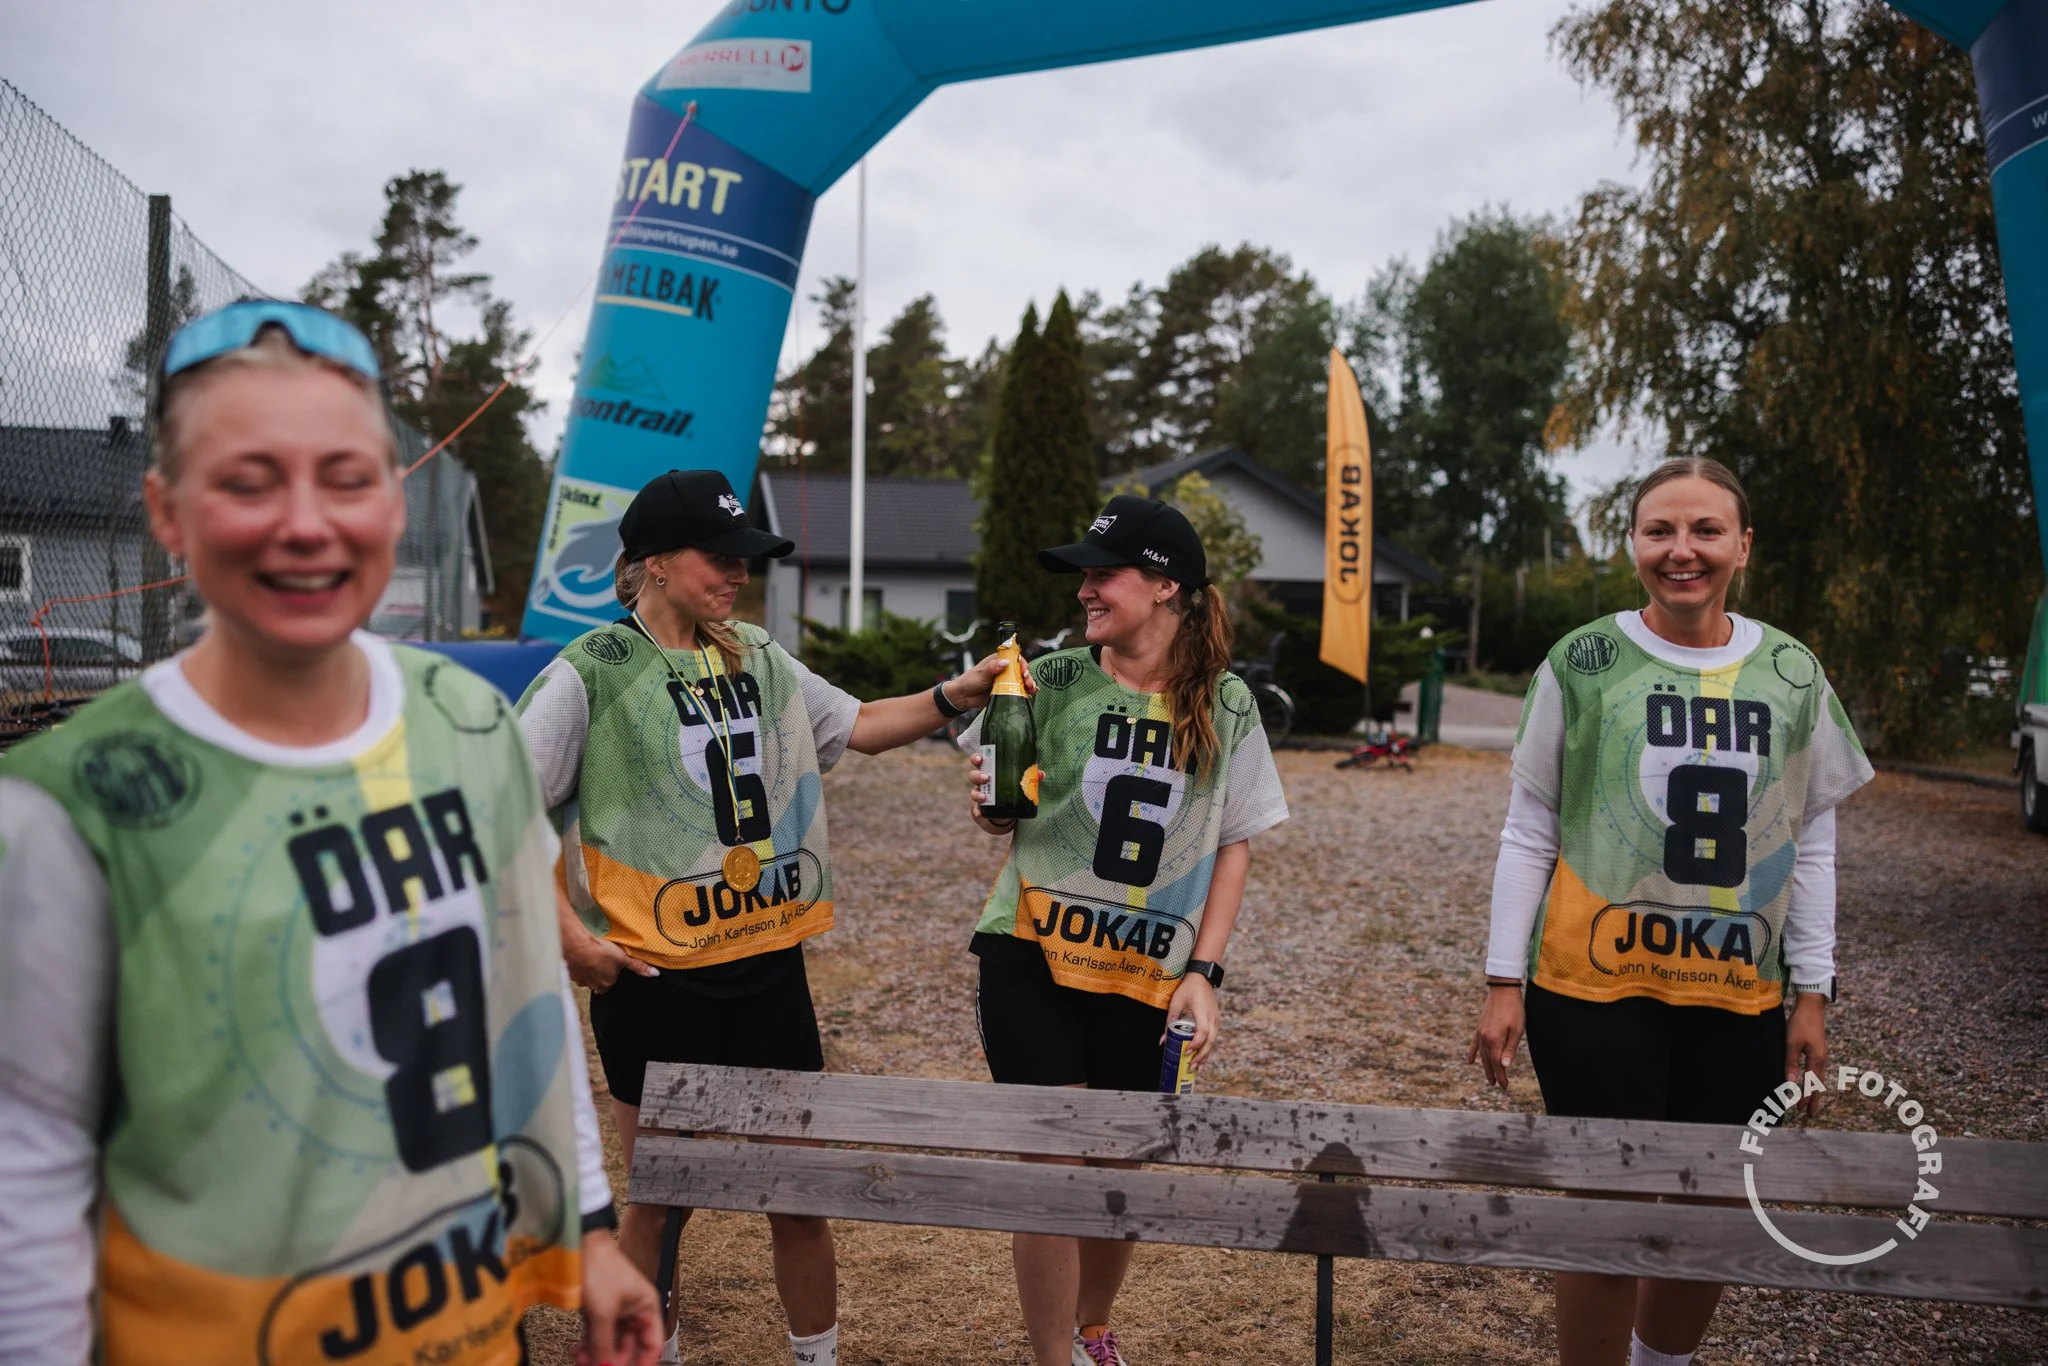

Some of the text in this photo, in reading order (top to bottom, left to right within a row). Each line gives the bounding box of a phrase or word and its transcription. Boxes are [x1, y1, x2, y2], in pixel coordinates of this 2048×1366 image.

[578, 398, 695, 437] ontrail
[1143, 548, 1170, 566] M&M
[1340, 464, 1361, 584] JOKAB
[667, 672, 762, 727] ÖAR
[1646, 684, 1772, 757] ÖAR
[705, 731, 772, 847] 6
[1092, 774, 1172, 888] 6
[1663, 764, 1748, 888] 8
[287, 788, 488, 938] ÖAR
[683, 861, 802, 927] JOKAB
[690, 934, 721, 949] John
[724, 919, 776, 941] Karlsson
[1033, 900, 1176, 960] JOKAB
[1062, 950, 1117, 972] Karlsson
[1118, 956, 1148, 977] Åkeri
[1149, 969, 1163, 982] AB
[1615, 960, 1645, 977] John
[1651, 963, 1718, 984] Karlsson
[367, 925, 495, 1175] 8
